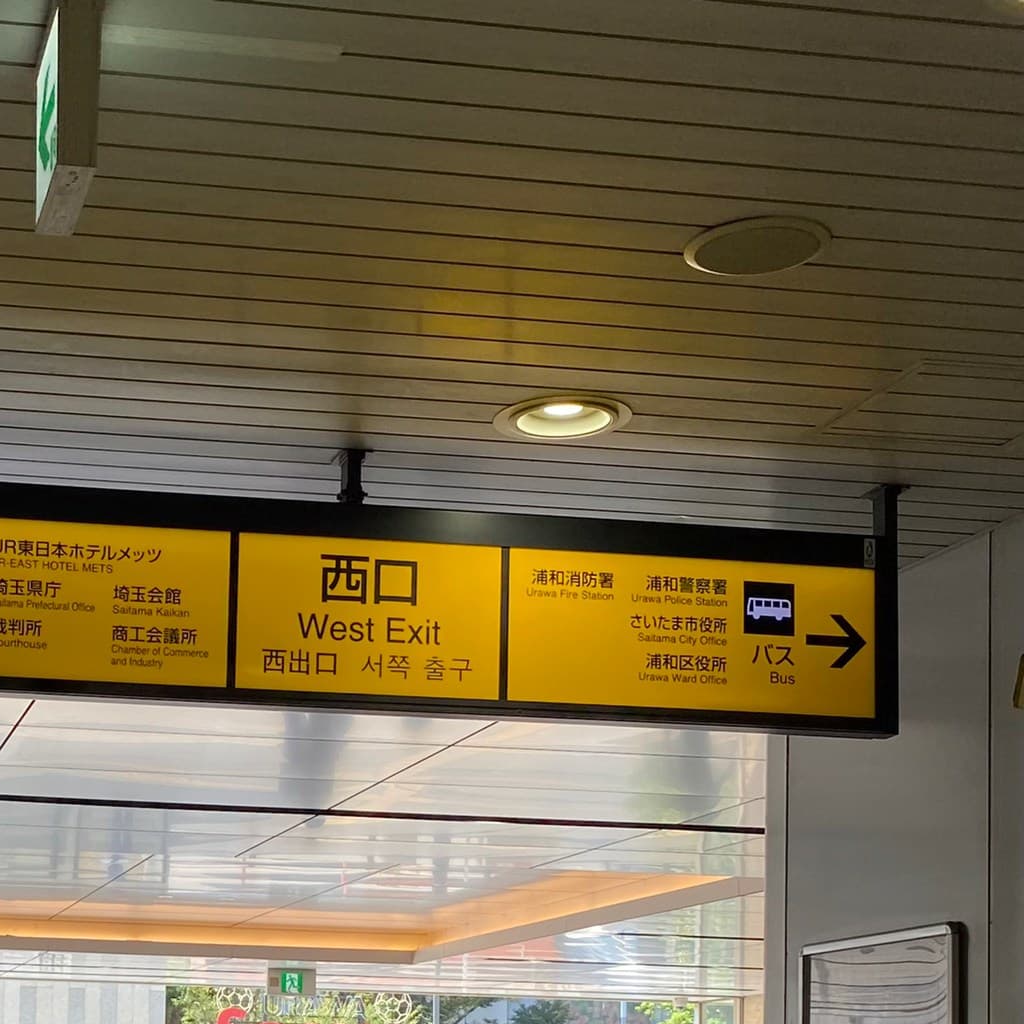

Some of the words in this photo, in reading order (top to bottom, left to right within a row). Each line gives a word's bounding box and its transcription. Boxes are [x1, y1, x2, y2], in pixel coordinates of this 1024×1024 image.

[42, 560, 79, 572] HOTEL
[82, 562, 113, 574] METS
[320, 554, 418, 606] 西口
[531, 568, 614, 589] 浦和消防署
[646, 575, 727, 595] 浦和警察署
[113, 584, 182, 605] 埼玉会館
[526, 587, 558, 598] Urawa
[560, 588, 578, 600] Fire
[581, 590, 614, 601] Station
[631, 593, 662, 604] Urawa
[664, 594, 693, 606] Police
[695, 596, 728, 607] Station
[26, 599, 70, 611] Prefectural
[71, 601, 96, 613] Office
[112, 604, 153, 616] Saitama
[156, 605, 190, 618] Kaikan
[297, 612, 374, 642] West
[387, 617, 441, 646] Exit
[630, 613, 727, 634] さいたま市役所
[112, 625, 198, 645] 商工会議所
[637, 632, 676, 643] Saitama
[678, 634, 698, 646] City
[699, 635, 727, 646] Office
[111, 644, 149, 655] Chamber
[152, 645, 161, 656] of
[163, 646, 209, 658] Commerce
[752, 644, 794, 666] バス
[111, 656, 126, 666] and
[129, 657, 163, 669] Industry
[262, 648, 337, 675] 西出口
[361, 653, 411, 679] 서쪽
[424, 656, 473, 681] 출구
[646, 653, 727, 673] 浦和区役所
[638, 672, 669, 683] Urawa
[671, 673, 697, 683] Ward
[699, 674, 727, 685] Office
[770, 671, 795, 685] Bus
